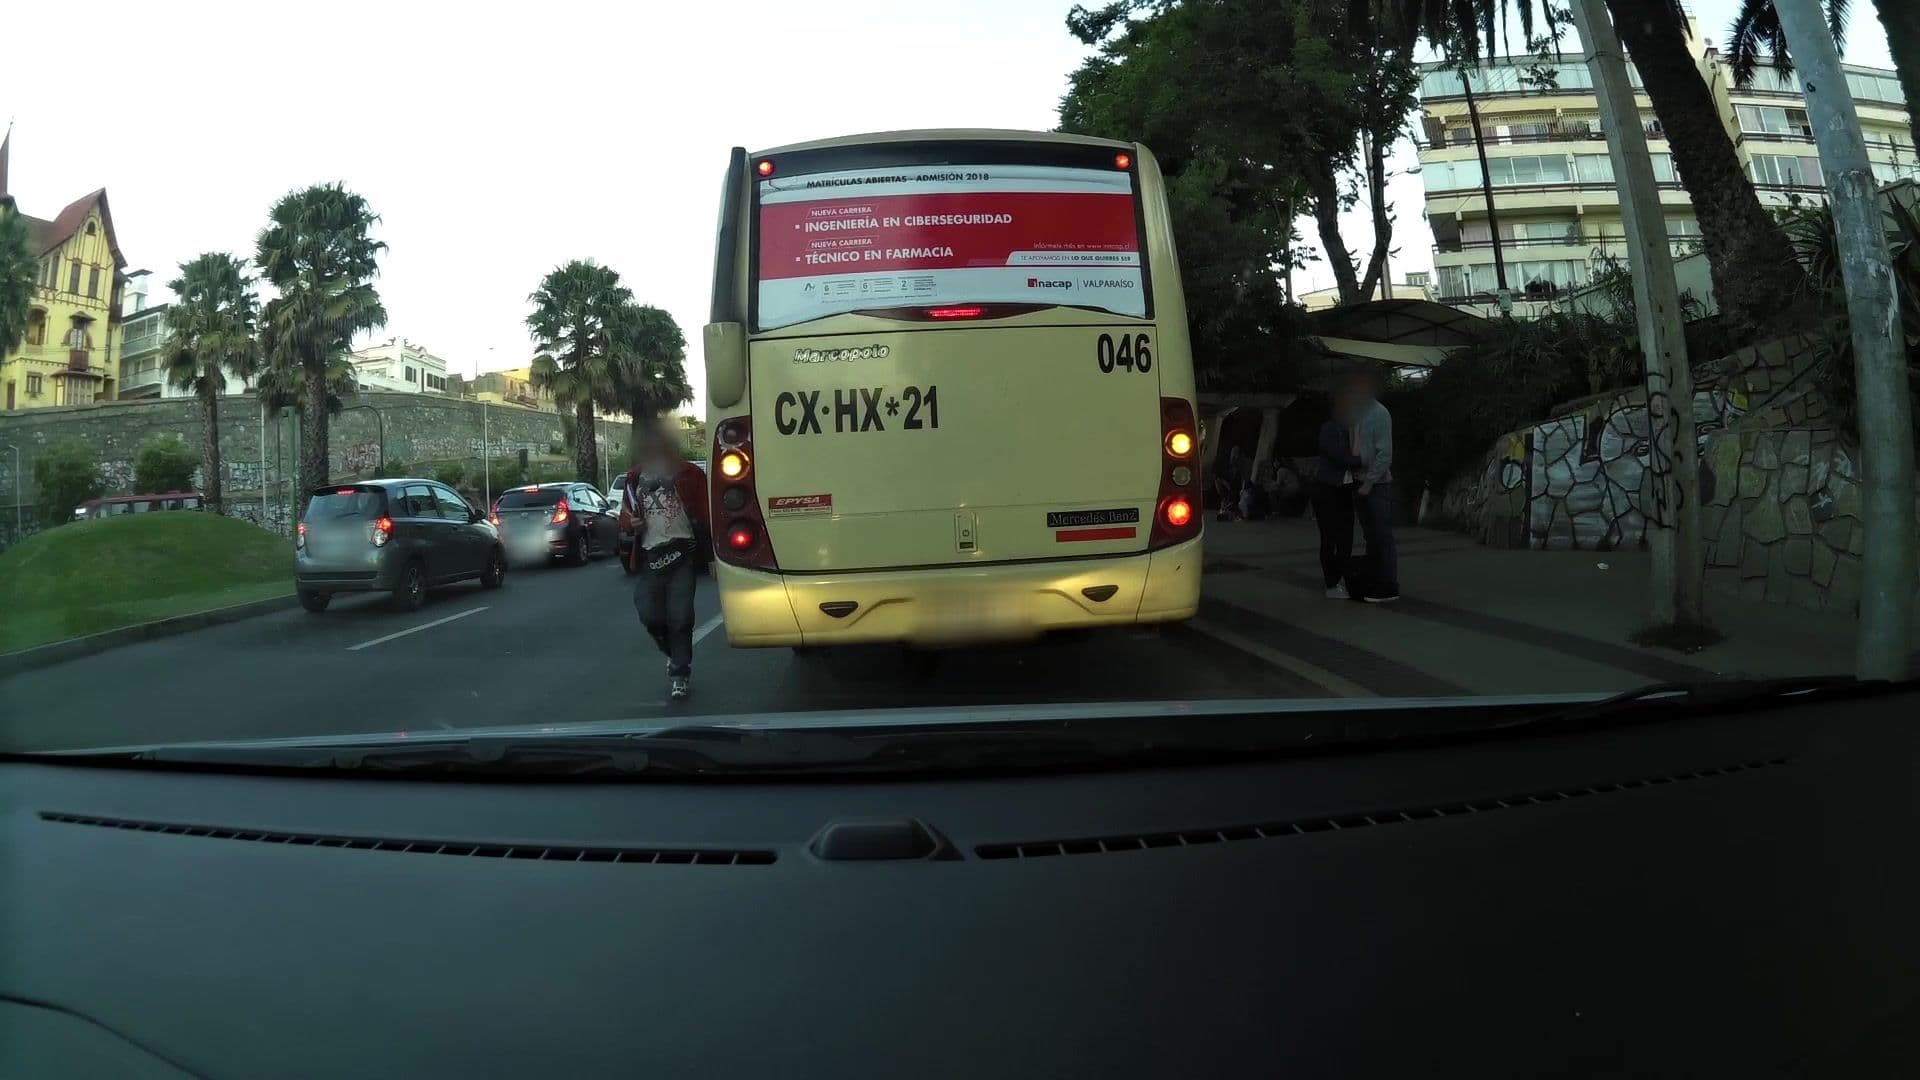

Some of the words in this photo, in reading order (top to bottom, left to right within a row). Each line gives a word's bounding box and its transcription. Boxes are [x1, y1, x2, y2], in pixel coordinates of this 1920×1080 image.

[865, 175, 907, 184] ABIERTAS
[916, 172, 963, 182] ADMISIÓN
[965, 172, 990, 181] 2018
[811, 208, 837, 217] NUEVA
[838, 206, 872, 215] CARRERA
[804, 216, 879, 232] INGENIERÍA
[883, 217, 900, 228] EN
[904, 213, 1012, 226] CIBERSEGURIDAD
[811, 241, 837, 249] NUEVA
[838, 238, 872, 247] CARRERA
[804, 251, 860, 265] TÉCNICO
[864, 250, 881, 260] EN
[886, 246, 954, 260] FARMACIA
[1083, 278, 1134, 289] VALPARAÍSO
[793, 344, 890, 364] Marcopolo
[1097, 333, 1152, 374] 046
[775, 496, 820, 506] EPYSA
[649, 550, 682, 570] adidas
